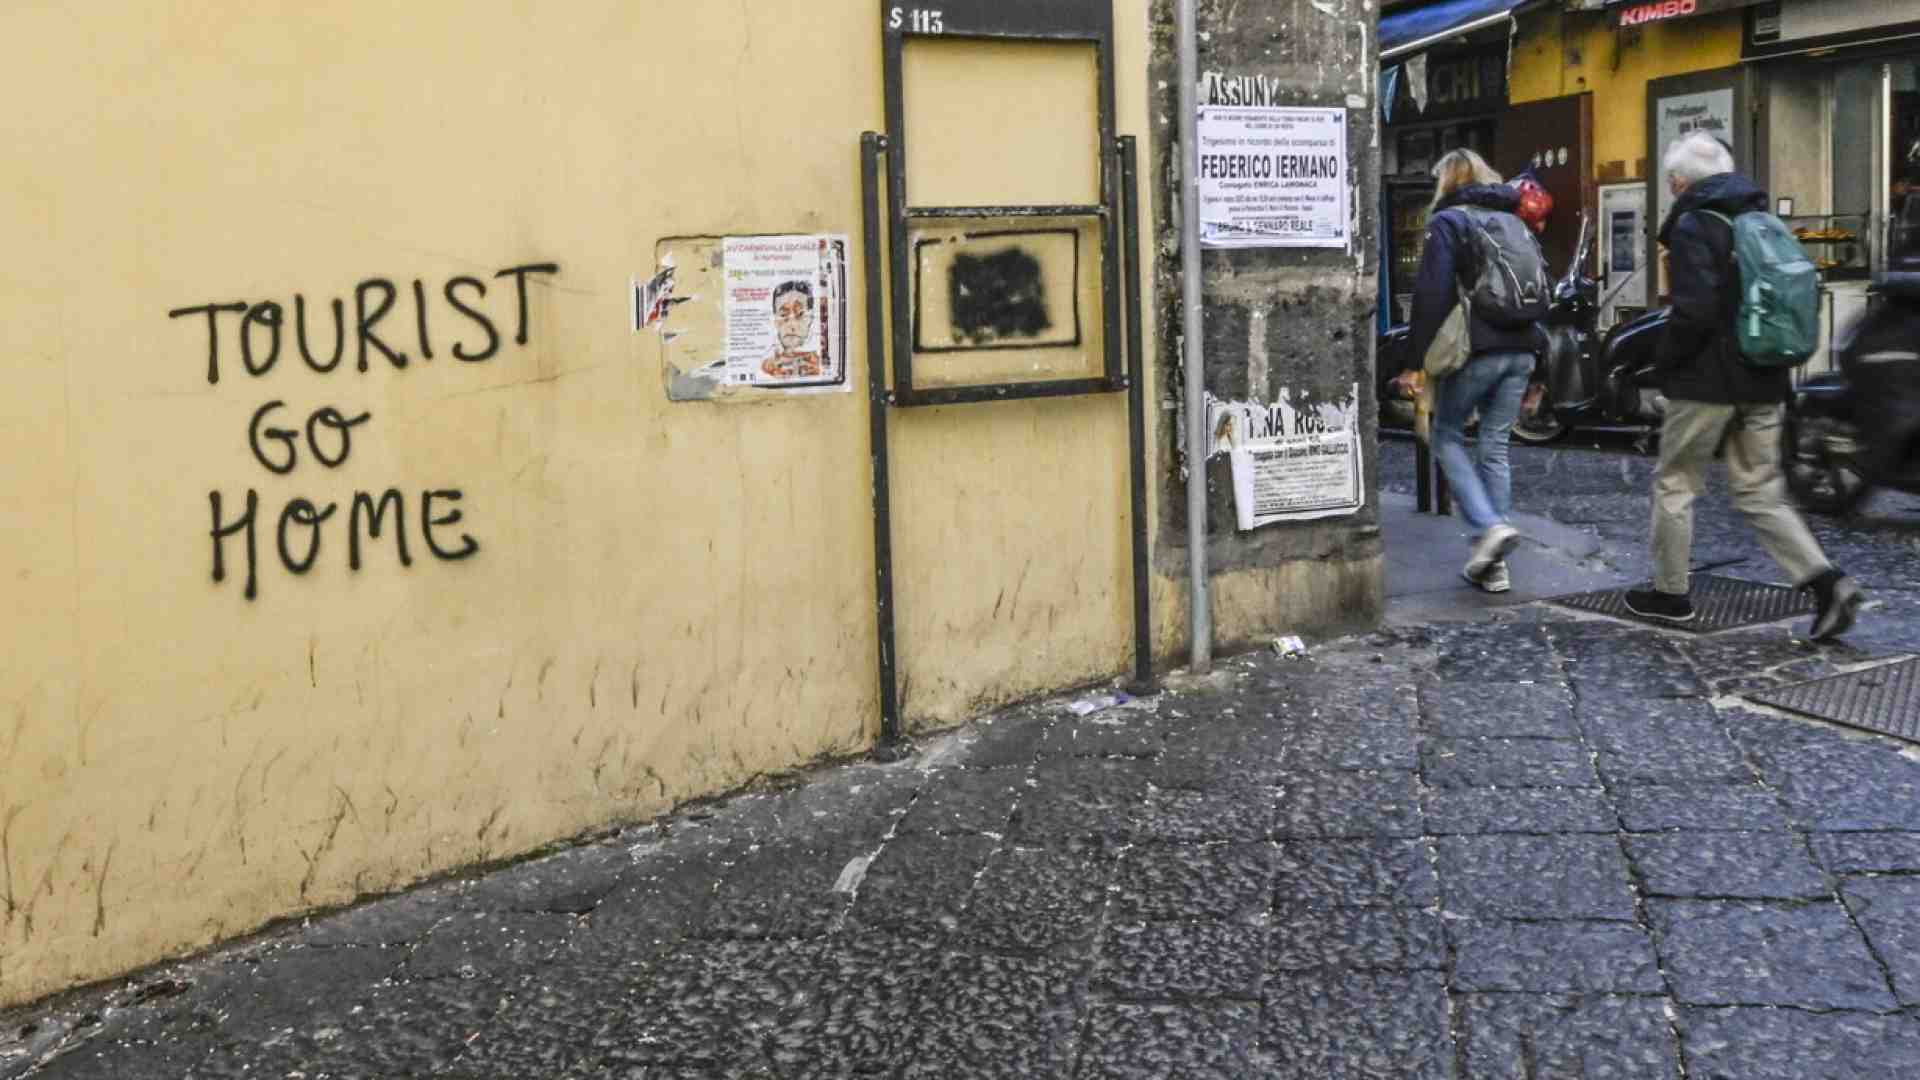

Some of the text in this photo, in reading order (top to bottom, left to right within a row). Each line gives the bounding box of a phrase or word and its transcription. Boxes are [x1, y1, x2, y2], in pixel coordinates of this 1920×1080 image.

[889, 7, 944, 34] S 113
[1619, 0, 1697, 26] KIMBO
[1201, 154, 1338, 179] FEDERICO IERMANO
[169, 263, 559, 384] TOURIST
[248, 400, 371, 475] GO
[210, 487, 479, 600] HOME
